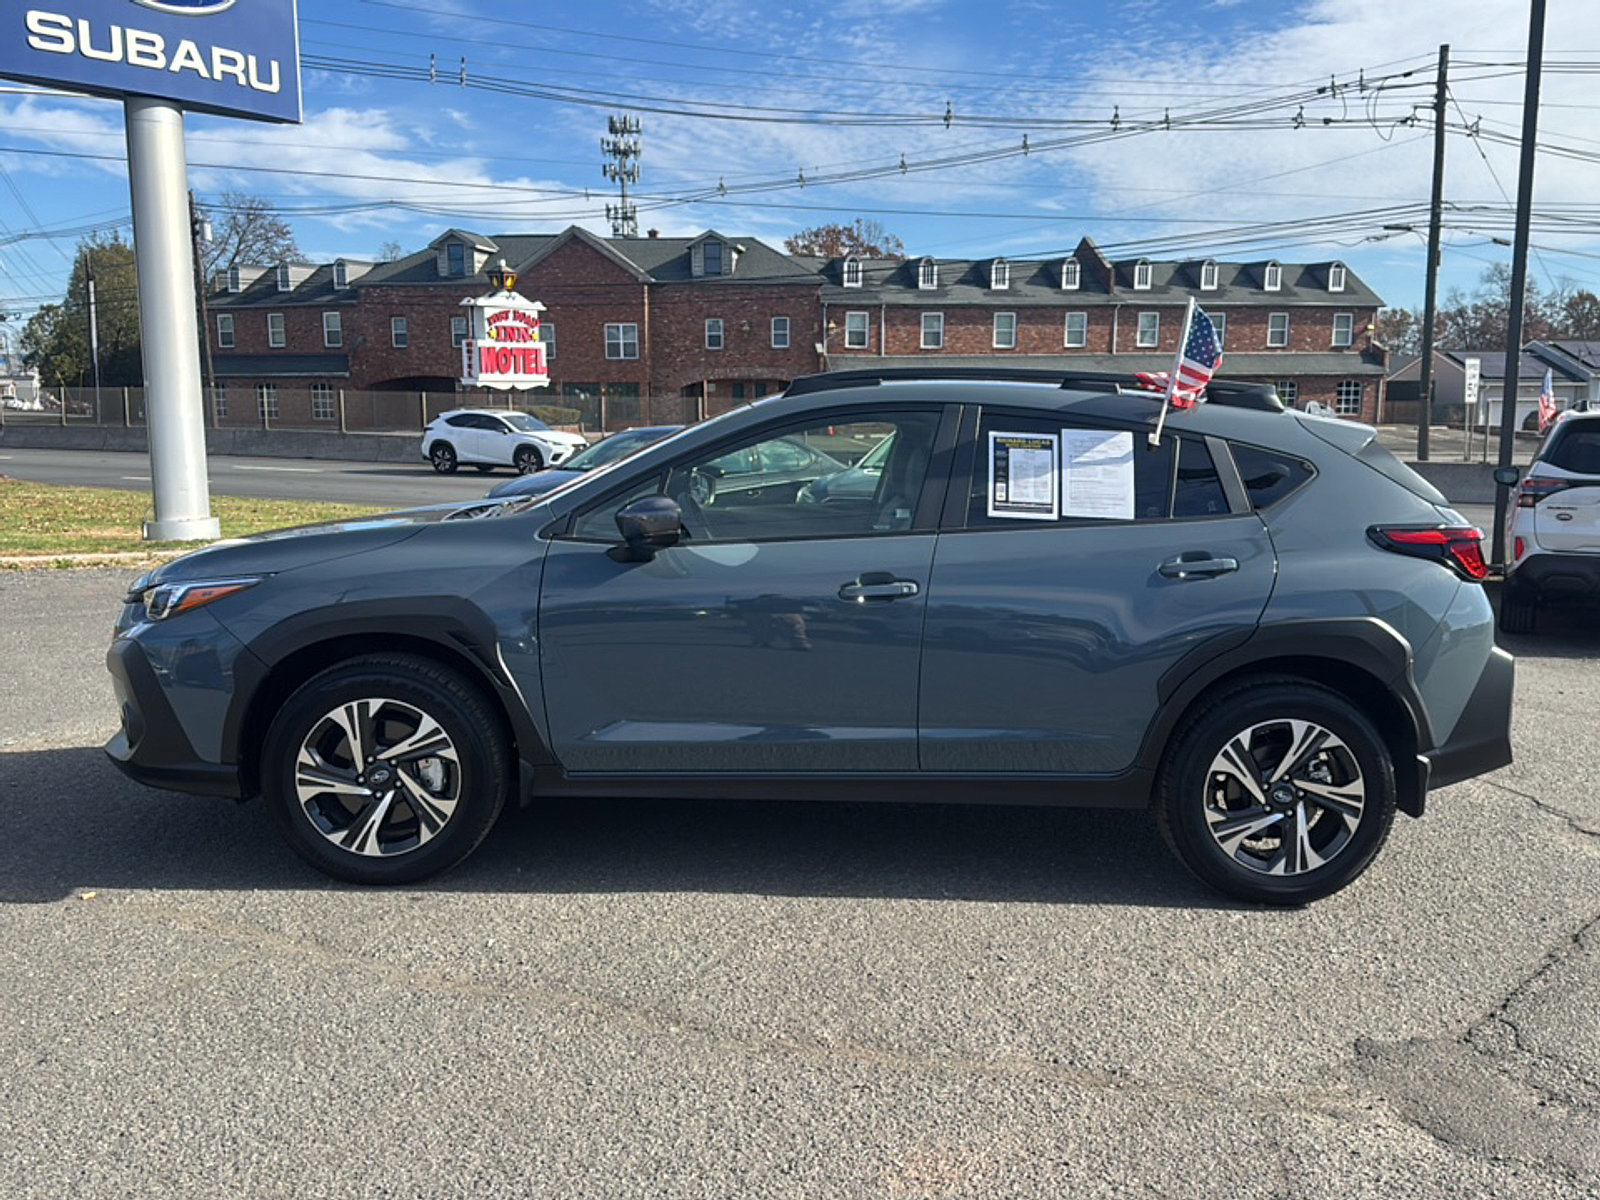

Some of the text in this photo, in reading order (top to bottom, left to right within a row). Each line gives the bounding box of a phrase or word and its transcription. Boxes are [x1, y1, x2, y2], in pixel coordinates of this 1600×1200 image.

[25, 9, 281, 94] SUBARU
[495, 326, 532, 342] INN
[479, 347, 548, 374] MOTEL
